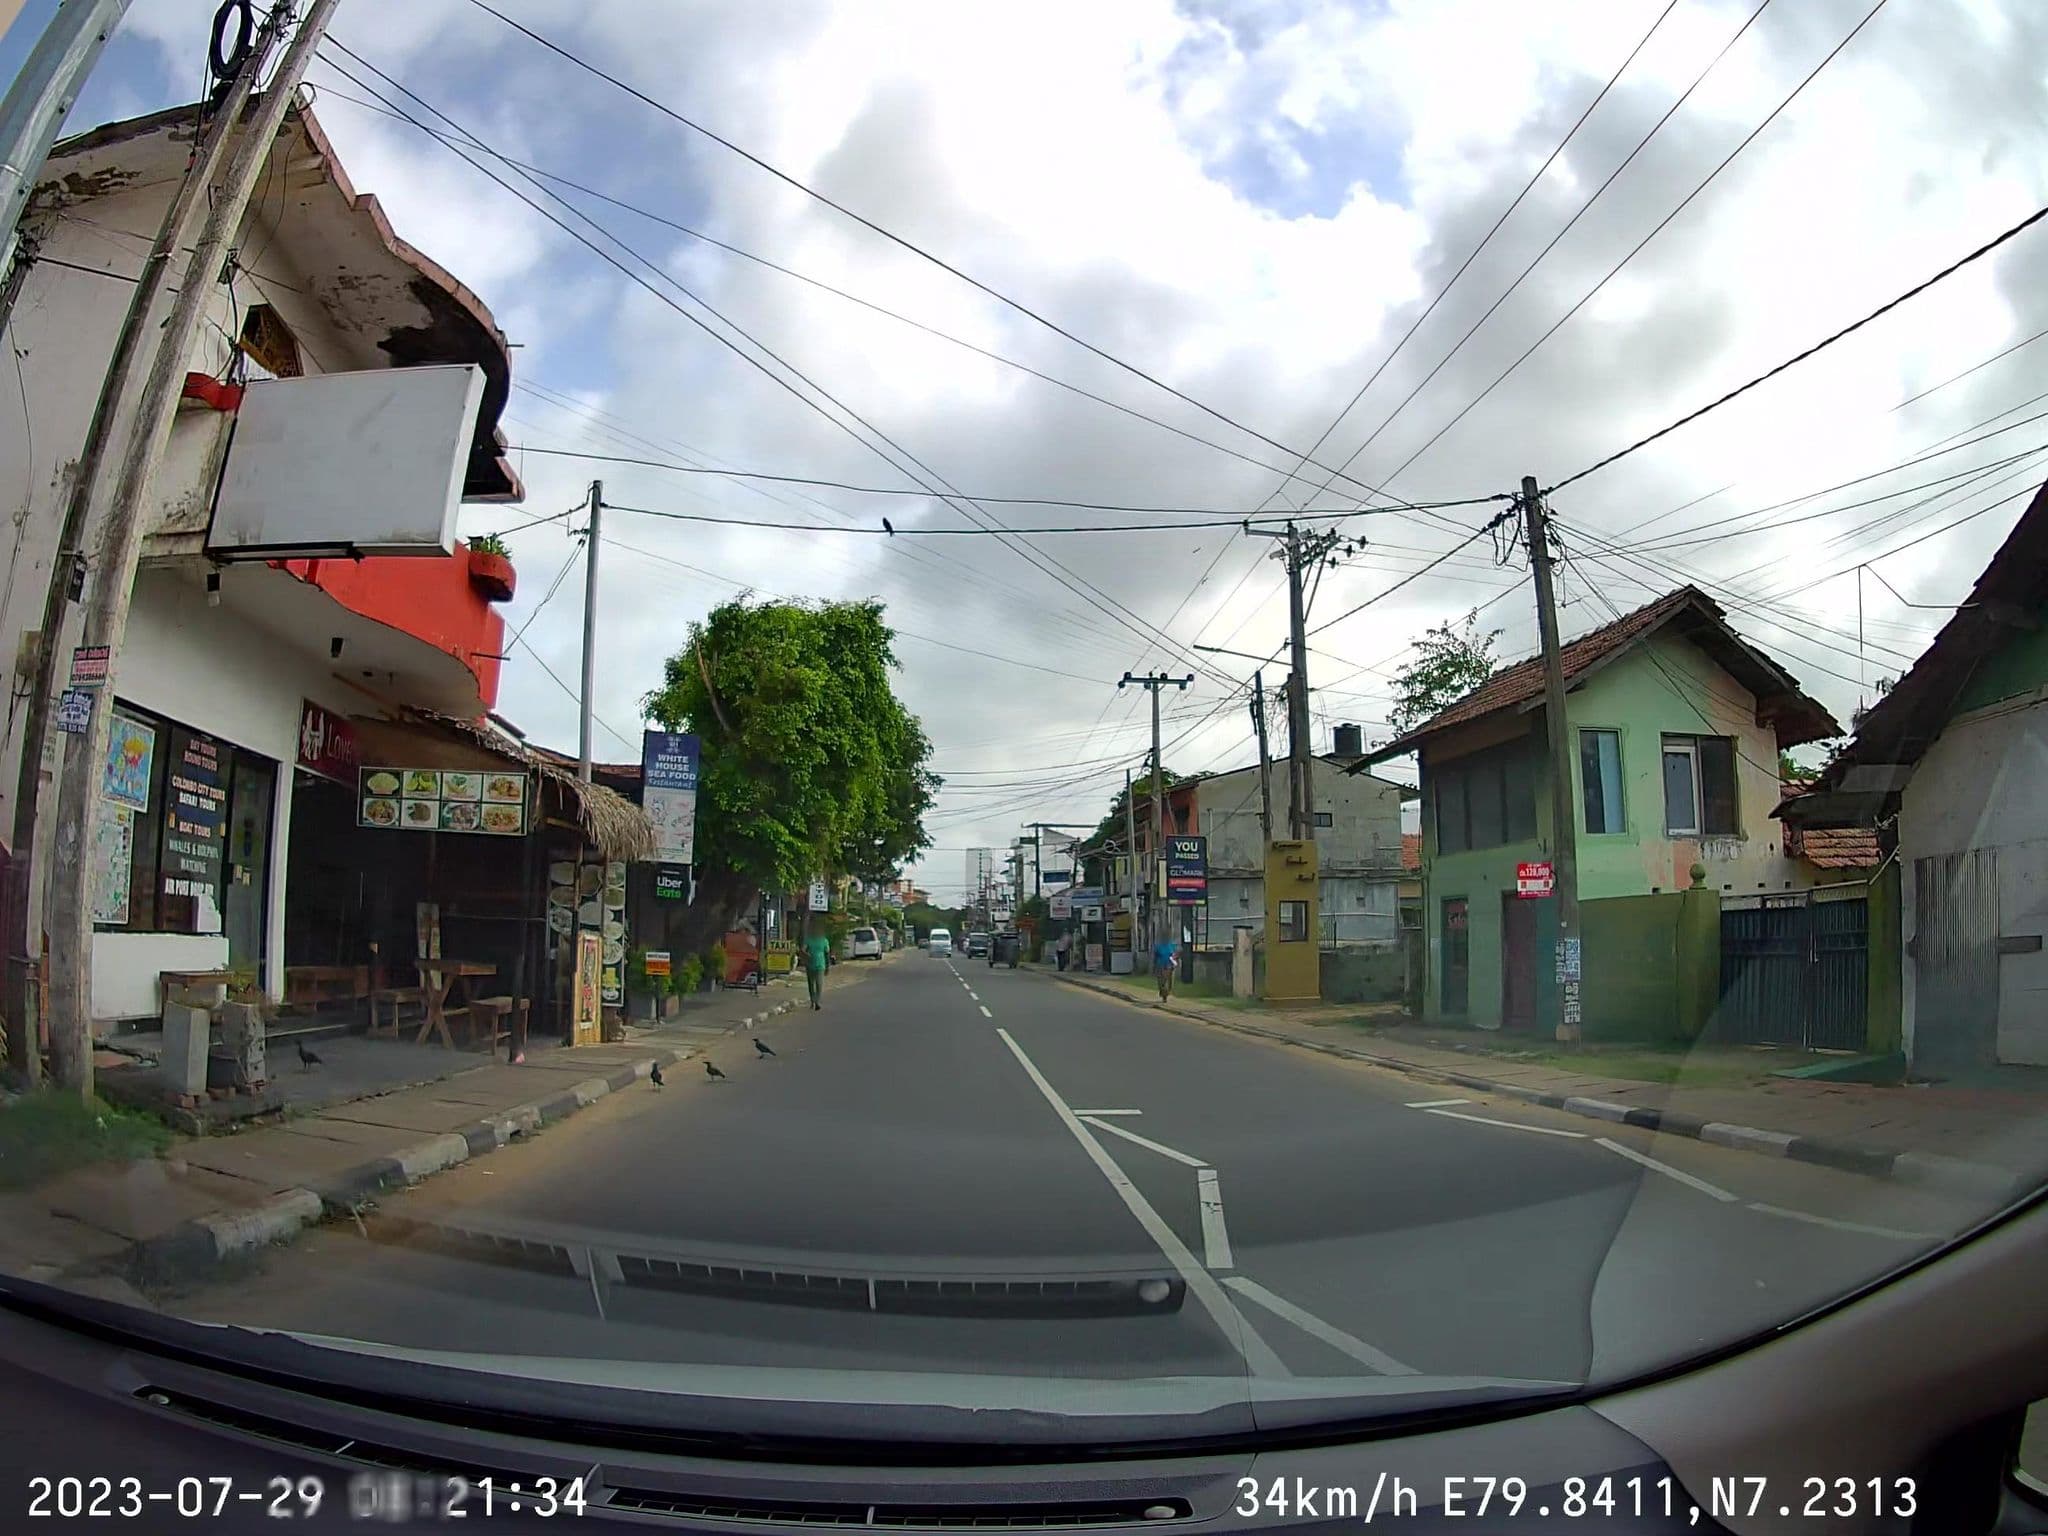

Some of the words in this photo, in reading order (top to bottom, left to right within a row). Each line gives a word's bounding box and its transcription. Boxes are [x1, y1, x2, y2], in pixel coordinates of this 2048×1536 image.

[657, 754, 689, 763] WHITE
[655, 762, 690, 772] HOUSE
[648, 770, 667, 778] SEA
[669, 771, 697, 780] FOOD
[172, 775, 198, 793] COLOMBO
[197, 782, 210, 796] CITY
[194, 823, 211, 838] TOURS
[1175, 841, 1198, 852] YOU
[657, 876, 683, 888] Uber
[656, 887, 682, 898] Eats
[770, 941, 791, 951] TAXI
